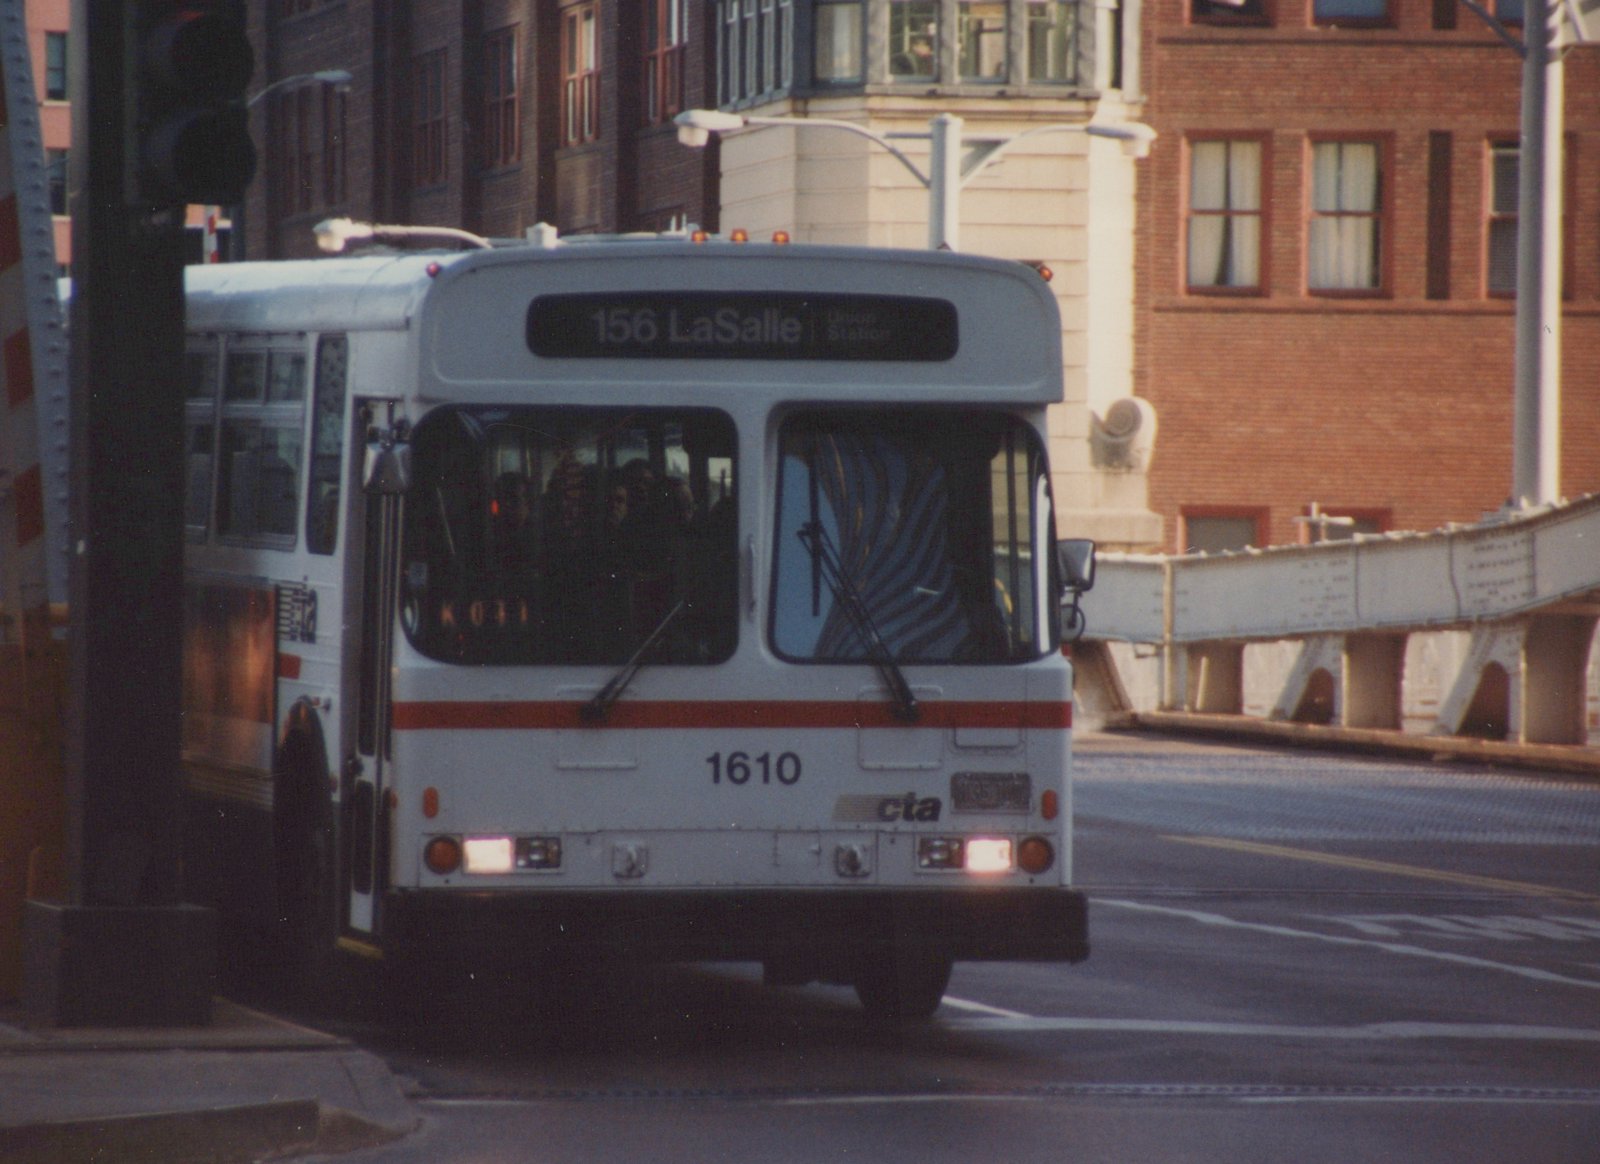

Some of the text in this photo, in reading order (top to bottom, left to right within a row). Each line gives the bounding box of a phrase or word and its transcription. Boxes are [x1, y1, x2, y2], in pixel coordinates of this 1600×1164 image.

[591, 307, 802, 344] 156 LaSalle
[705, 750, 802, 785] 1610
[877, 791, 942, 822] cta
